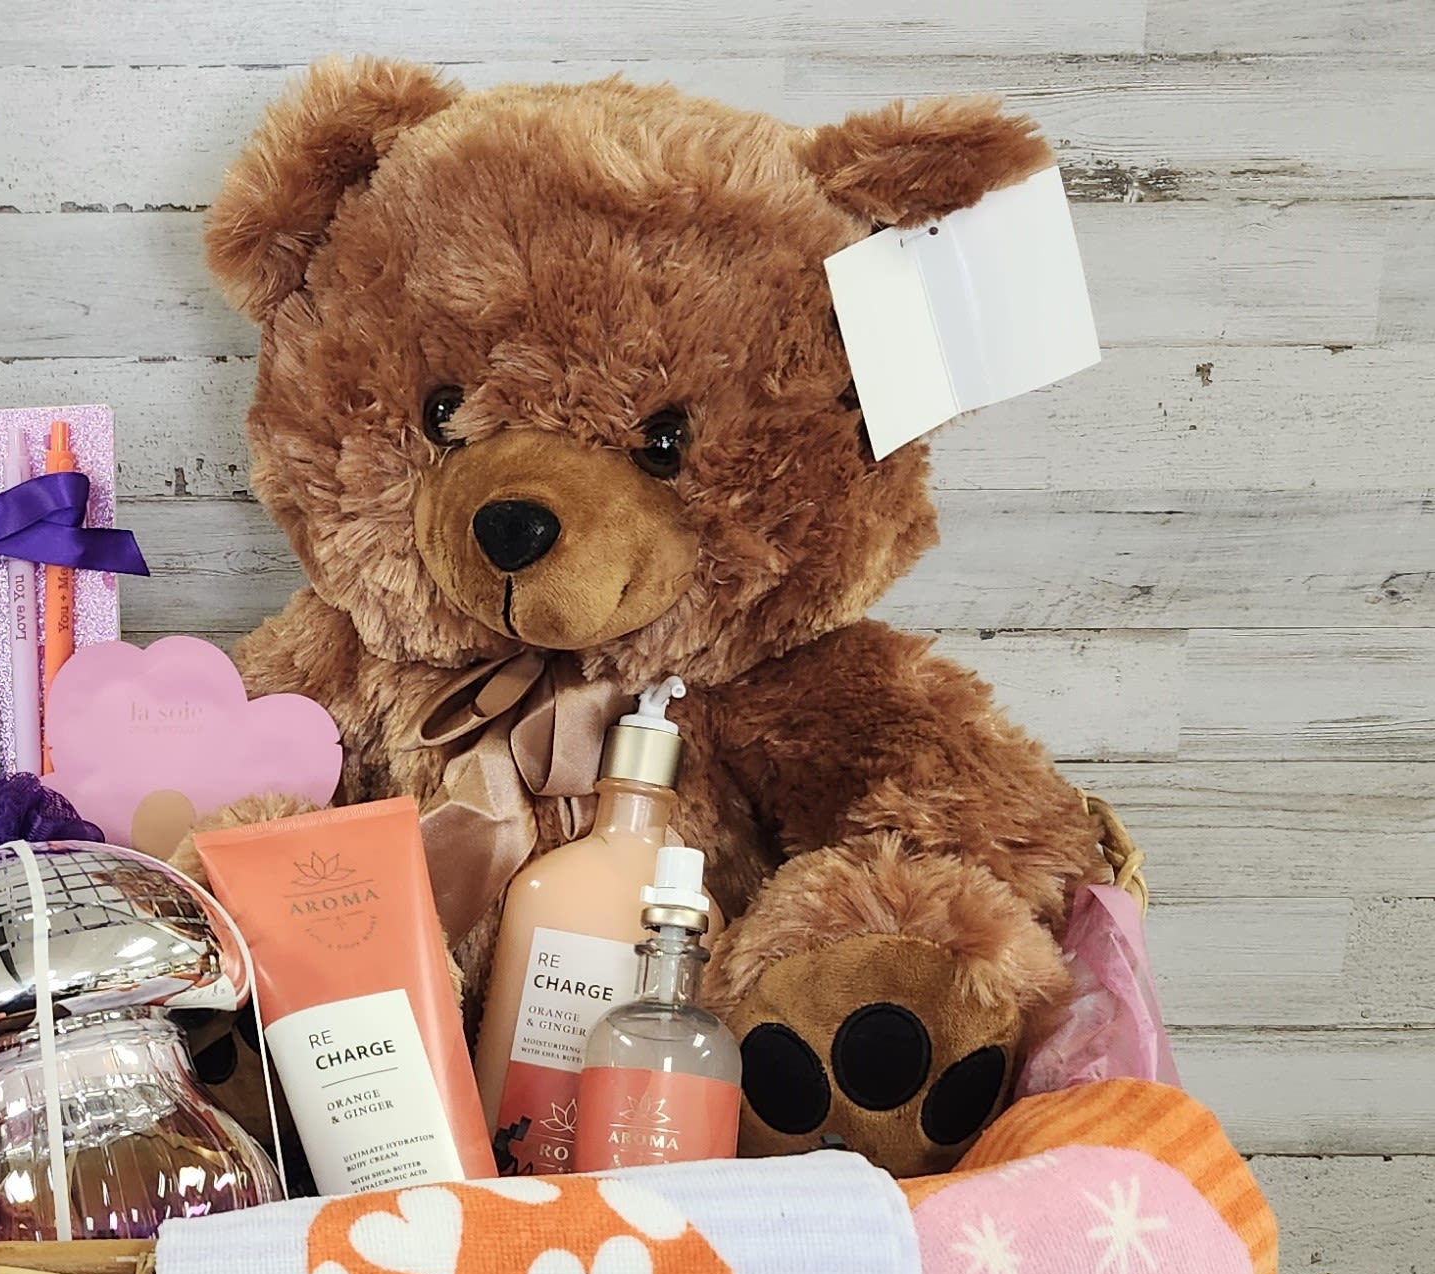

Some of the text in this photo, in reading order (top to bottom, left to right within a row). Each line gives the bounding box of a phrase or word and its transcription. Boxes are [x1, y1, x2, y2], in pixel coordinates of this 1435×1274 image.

[58, 568, 69, 591] Me
[14, 574, 27, 641] Love You
[58, 604, 69, 633] You
[291, 888, 380, 914] AROMA
[537, 952, 561, 969] RE
[533, 974, 614, 1002] CHARGE
[528, 1005, 581, 1023] ORANGE
[308, 1029, 334, 1049] RE
[526, 1018, 587, 1037] & GINGER
[316, 1039, 397, 1070] CHARGE
[521, 1046, 540, 1056] WITH
[522, 1036, 581, 1054] MOISTURIZING
[327, 1088, 381, 1112] ORANGE
[331, 1099, 395, 1125] & GINGER
[343, 1133, 435, 1163] ULTIMATE HYDRATION
[608, 1130, 679, 1151] AROMA
[347, 1151, 399, 1172] BODY CREAM
[351, 1160, 422, 1186] WITH SHEA BUTTER
[409, 1168, 428, 1179] ACID
